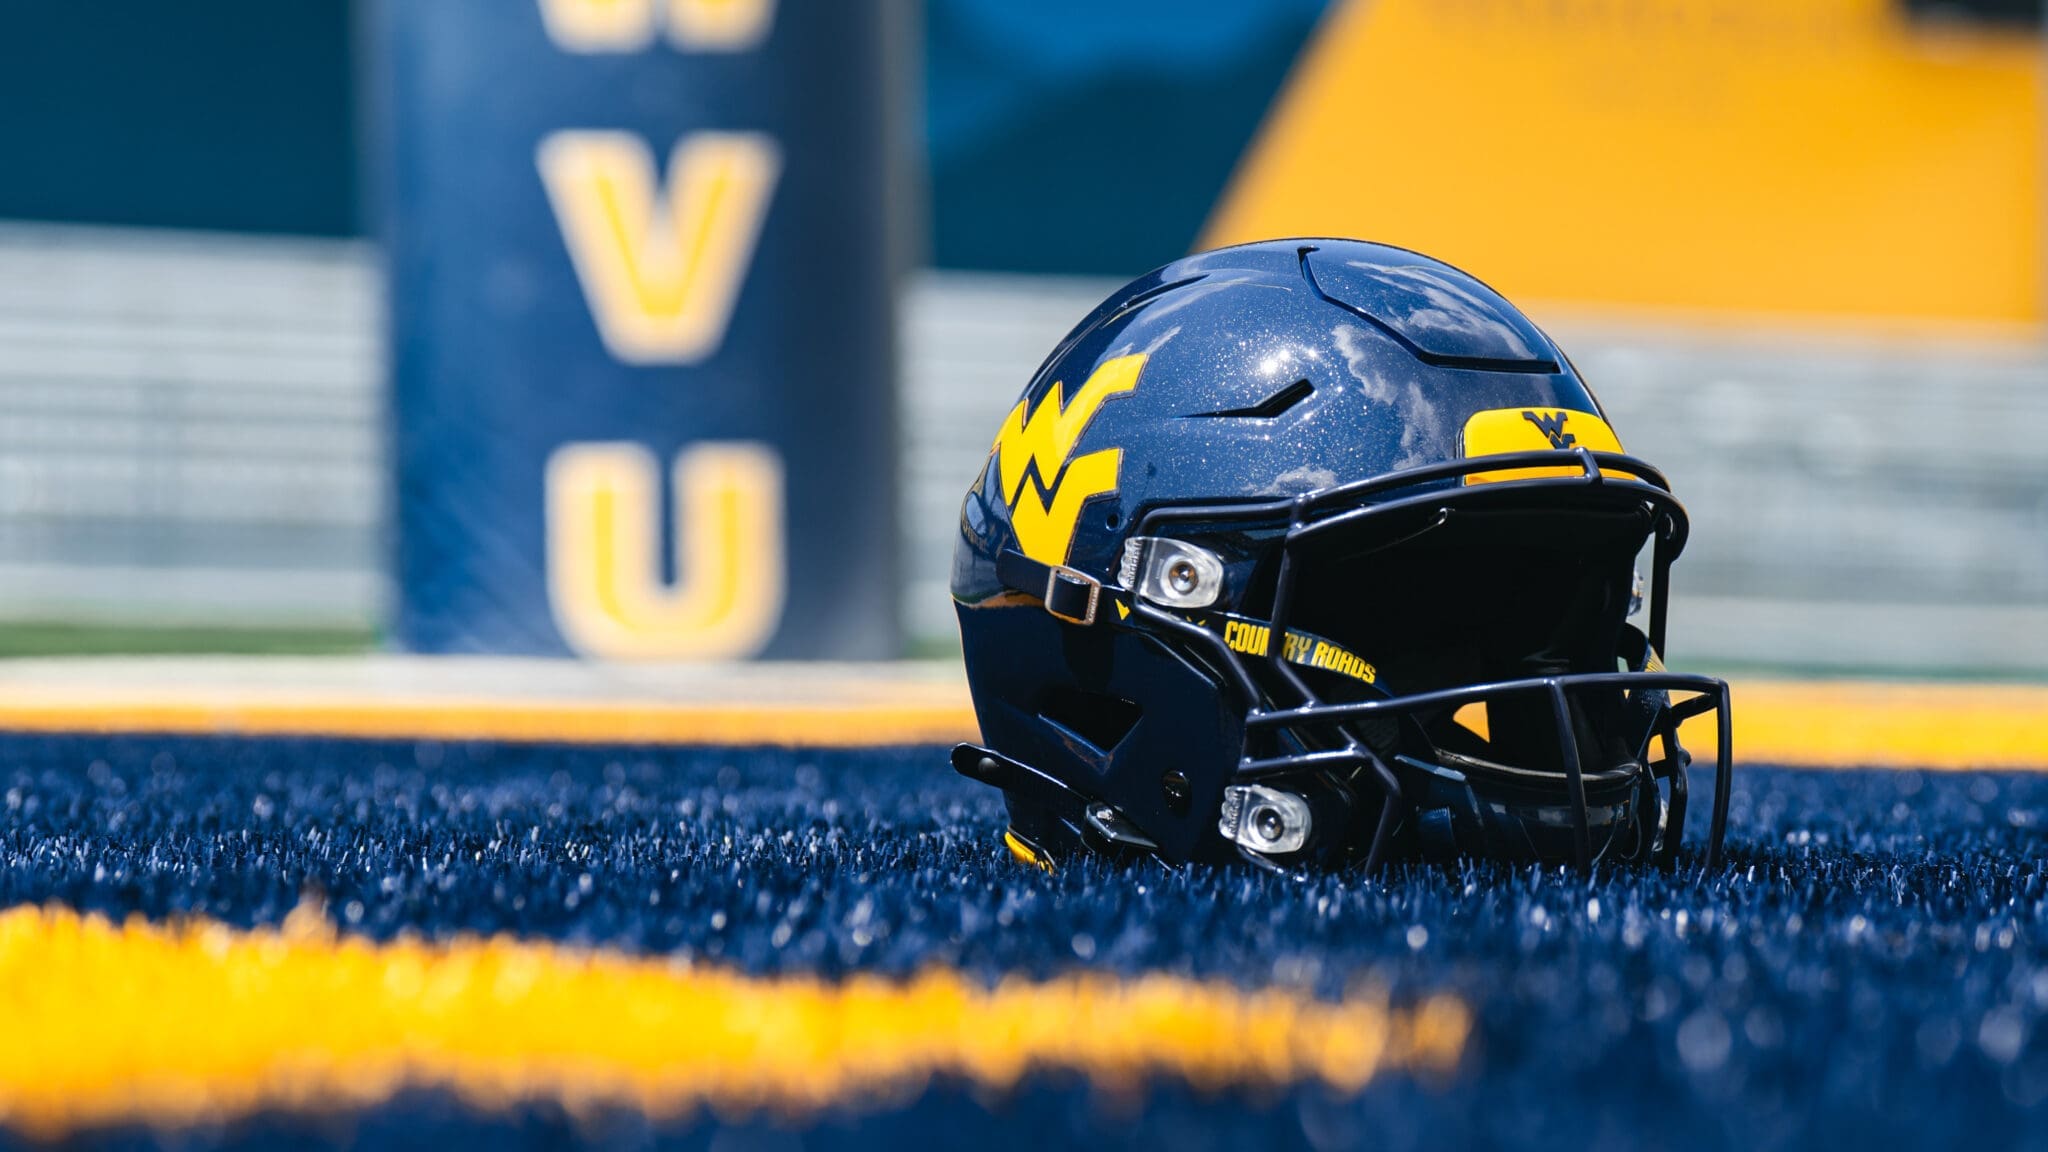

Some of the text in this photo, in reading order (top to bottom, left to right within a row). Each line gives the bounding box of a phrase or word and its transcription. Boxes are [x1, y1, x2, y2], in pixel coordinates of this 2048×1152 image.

[535, 0, 787, 663] VU
[1224, 620, 1376, 684] COUNRY ROADS
